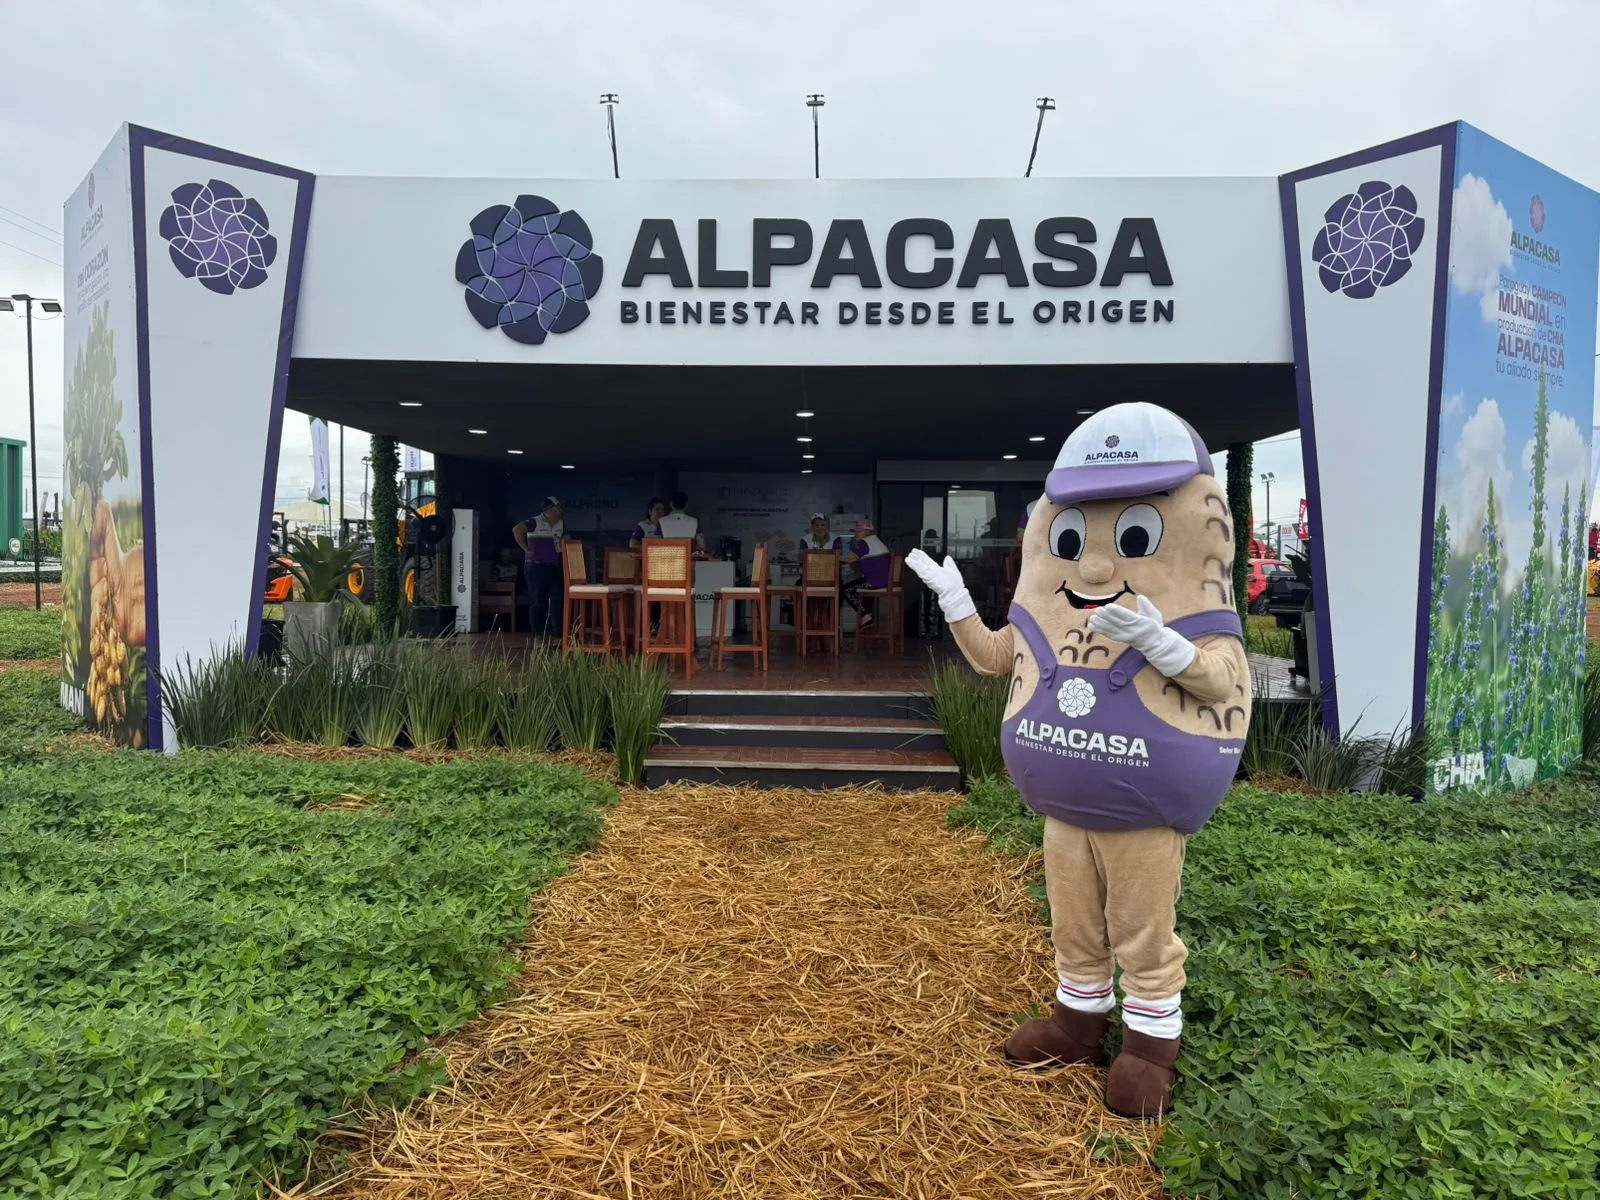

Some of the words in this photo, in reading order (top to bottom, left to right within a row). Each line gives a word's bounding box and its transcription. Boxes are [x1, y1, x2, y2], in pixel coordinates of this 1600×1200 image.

[622, 217, 1173, 289] ALPACASA
[1511, 231, 1560, 266] ALPACASA
[1500, 274, 1529, 299] Paraguay
[620, 301, 819, 325] BIENESTAR
[839, 301, 955, 325] DESDE
[972, 301, 1014, 325] EL
[1033, 300, 1174, 324] ORIGEN
[1499, 291, 1552, 326] MUNDIAL
[1555, 315, 1566, 331] en
[1497, 318, 1536, 338] producción
[1538, 328, 1546, 341] de
[1496, 358, 1505, 374] tu
[1497, 333, 1565, 370] ALPACASA
[1085, 451, 1139, 461] ALPACASA
[1015, 737, 1053, 753] BIENESTAR
[1056, 748, 1087, 759] DESDE
[1091, 754, 1103, 762] EL
[1108, 756, 1150, 768] ORIGEN
[1016, 718, 1149, 758] ALPACASA
